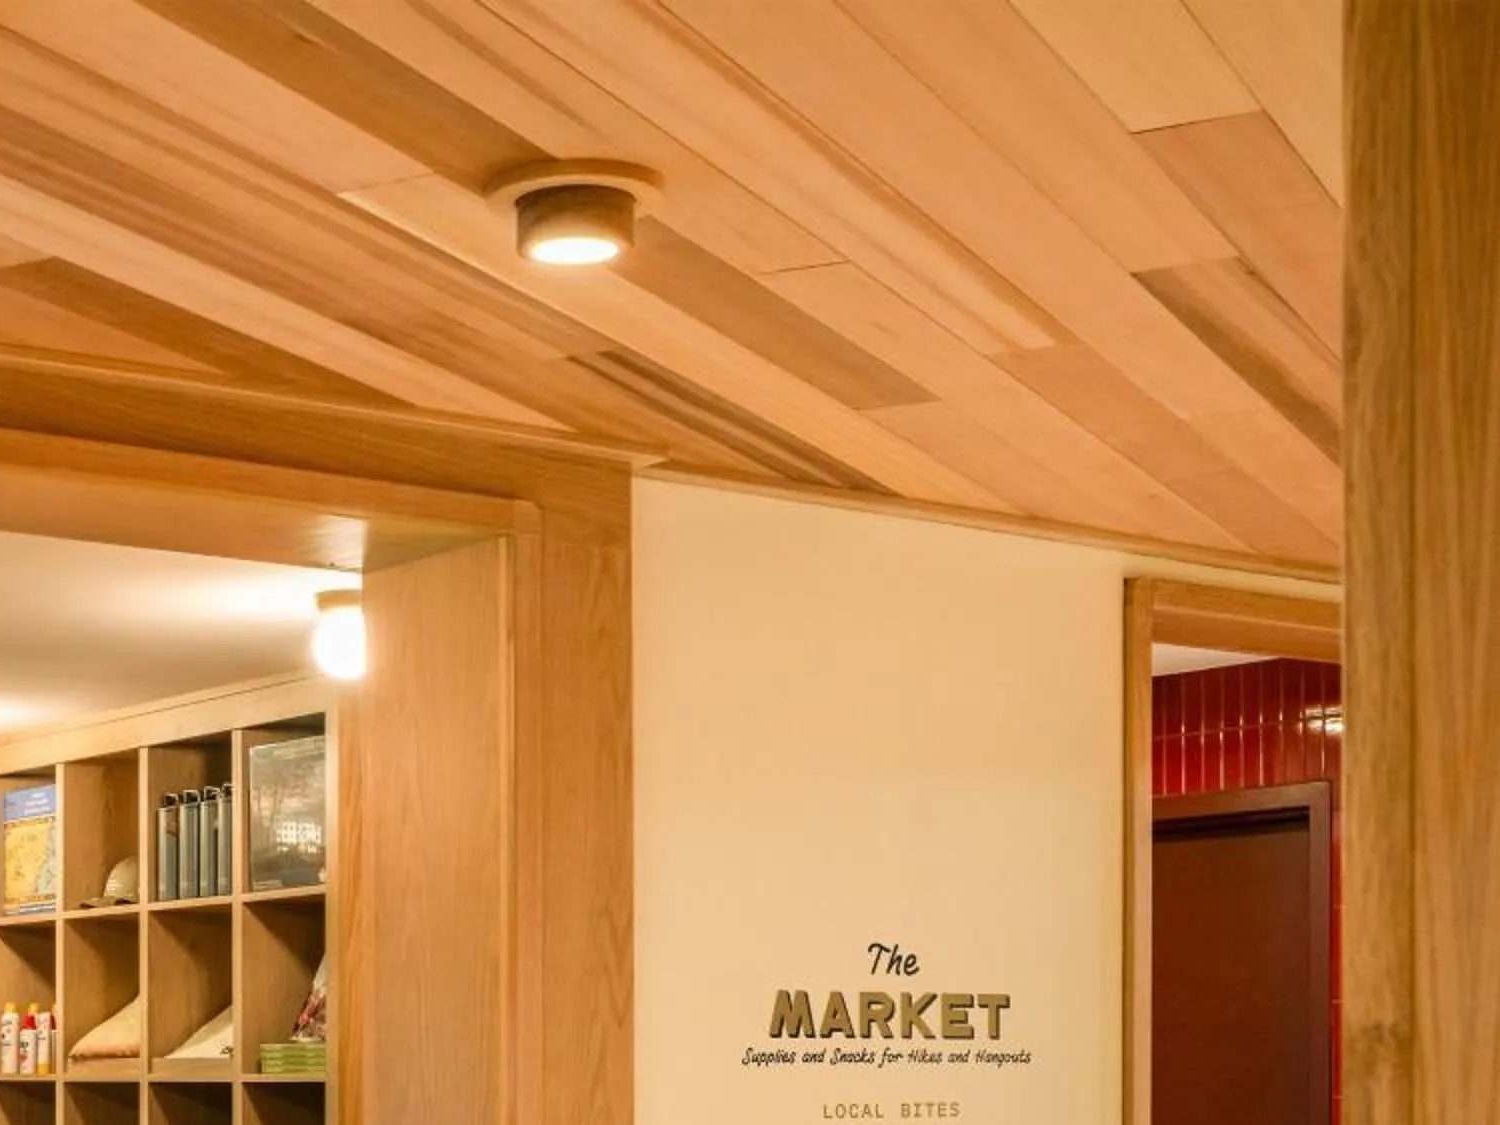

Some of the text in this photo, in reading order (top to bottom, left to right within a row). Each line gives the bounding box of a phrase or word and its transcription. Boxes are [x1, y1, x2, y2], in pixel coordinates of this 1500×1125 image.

[867, 942, 920, 976] The
[768, 989, 1011, 1040] MARKET
[741, 1047, 1031, 1068] Supplies and Snacks for Hikes and Hangouts
[823, 1102, 961, 1119] LOCAL BITES
